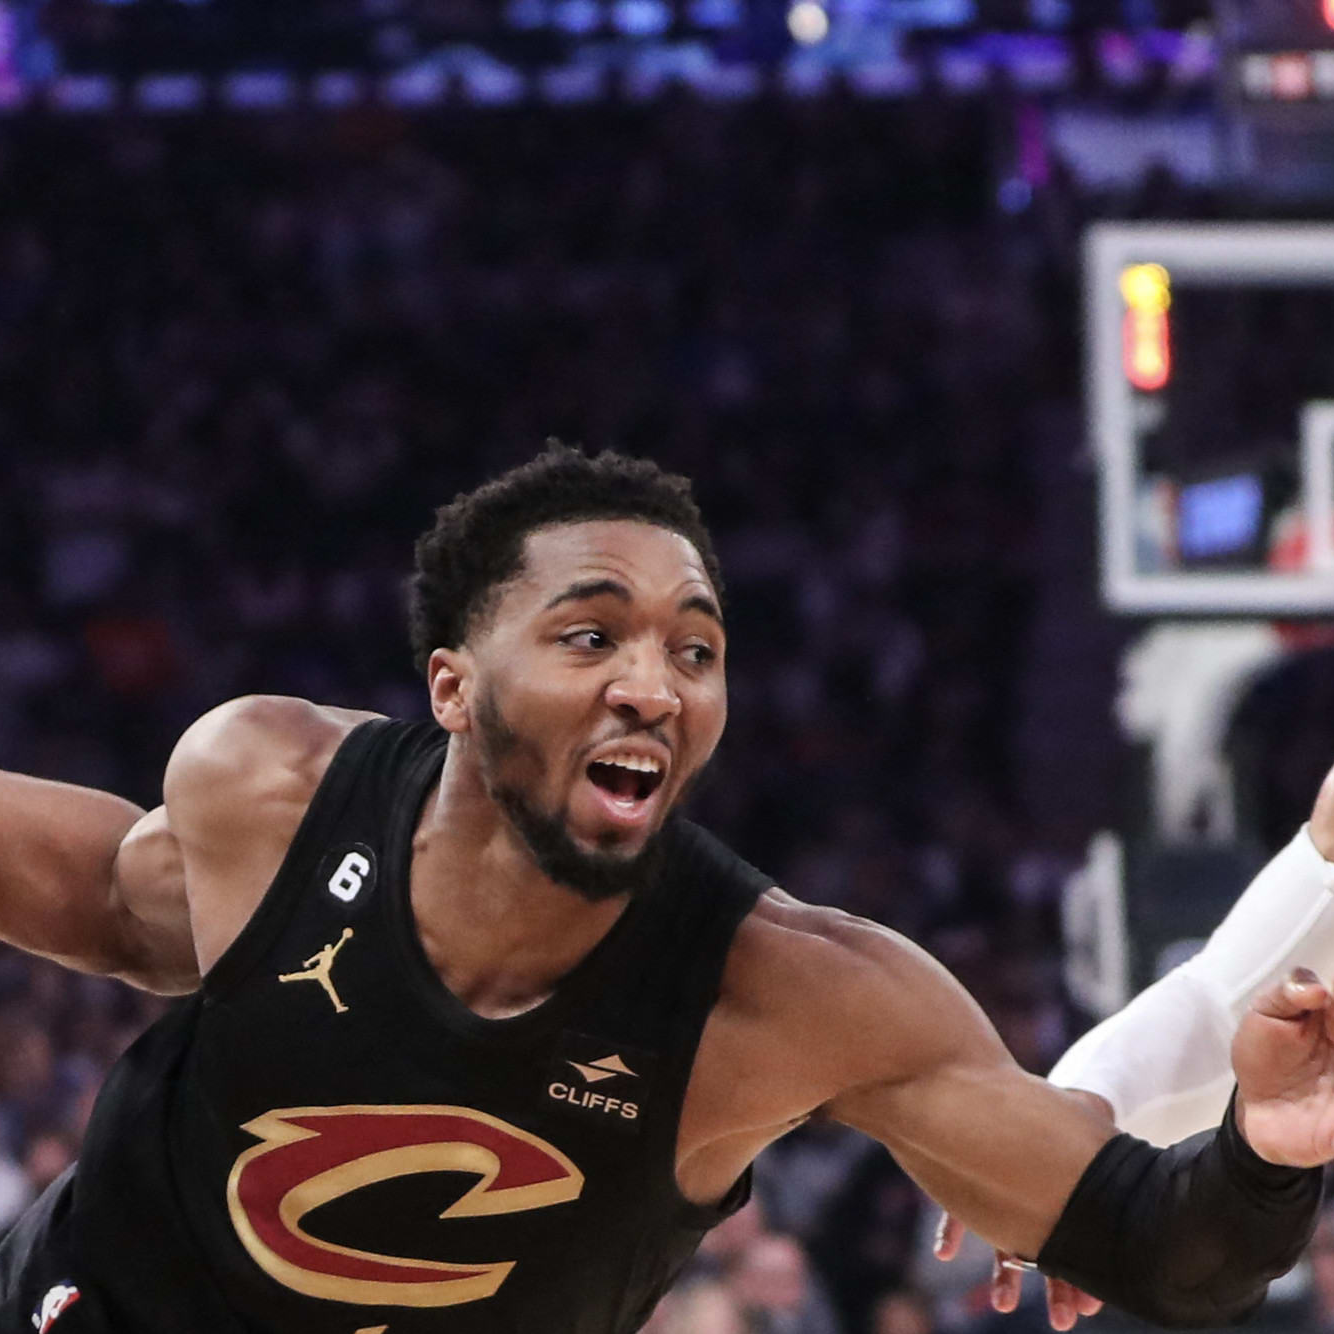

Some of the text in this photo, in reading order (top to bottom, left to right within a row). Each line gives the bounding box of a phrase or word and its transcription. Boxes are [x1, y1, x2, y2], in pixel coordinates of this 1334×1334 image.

[328, 851, 370, 902] 6
[548, 1082, 639, 1119] CLIFFS
[227, 1104, 585, 1307] C
